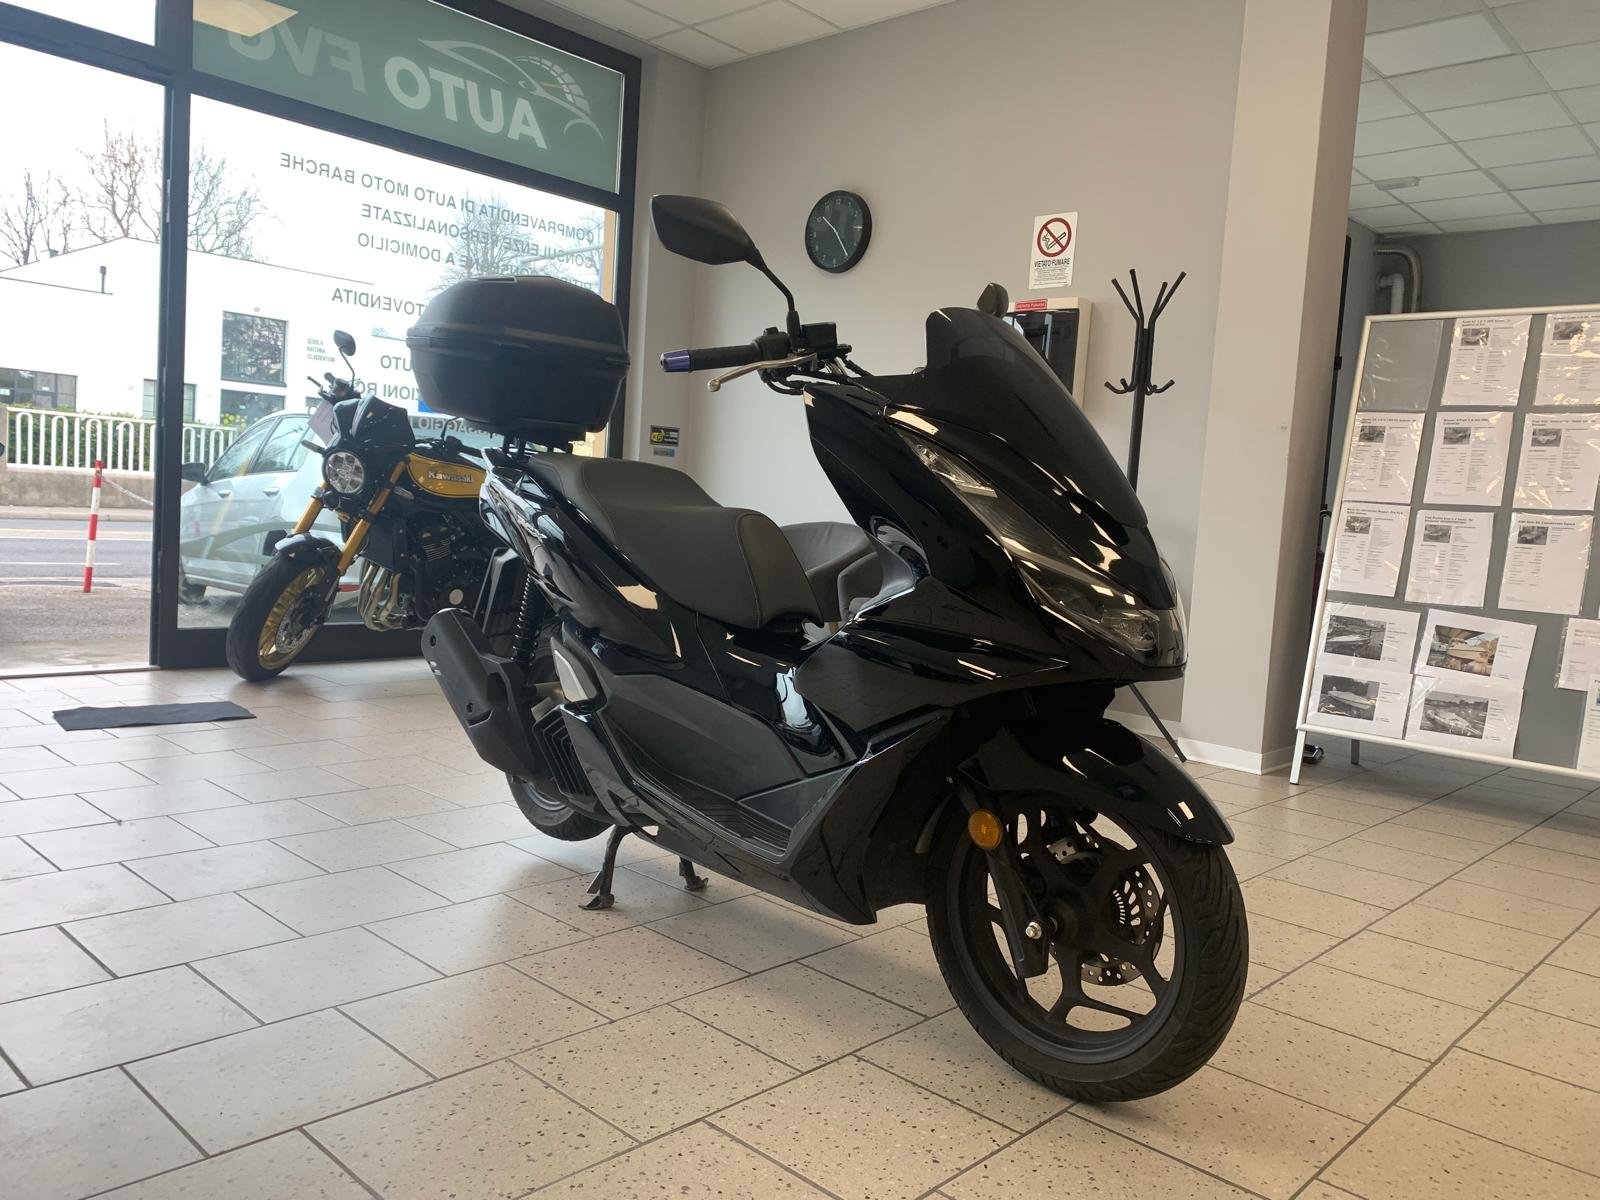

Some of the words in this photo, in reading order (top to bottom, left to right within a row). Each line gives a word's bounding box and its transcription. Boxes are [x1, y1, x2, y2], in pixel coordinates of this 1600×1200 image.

[1034, 259, 1051, 268] VIETATO
[1052, 257, 1070, 267] FUMARE
[428, 470, 474, 483] Kawasaki
